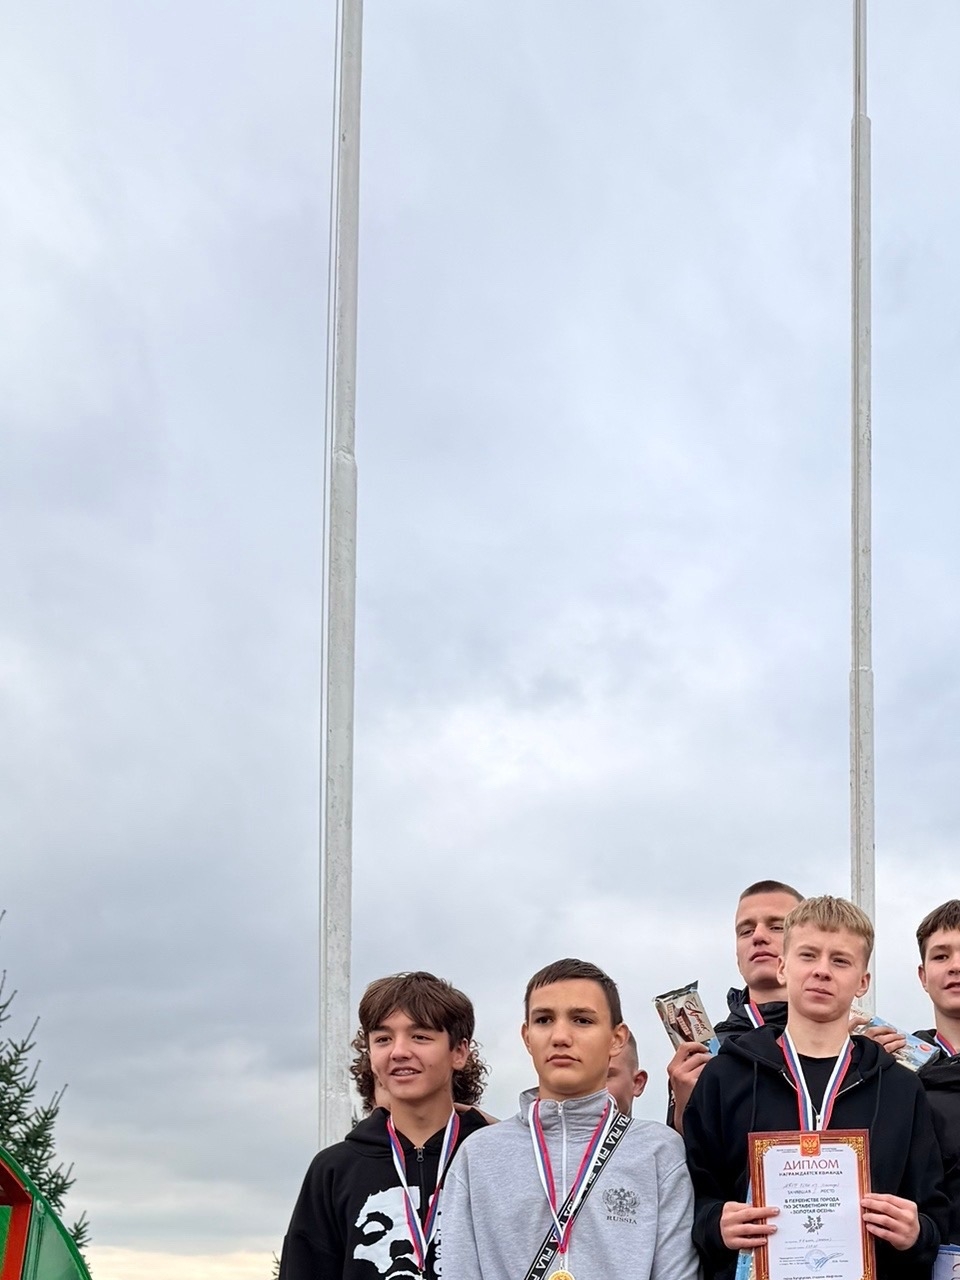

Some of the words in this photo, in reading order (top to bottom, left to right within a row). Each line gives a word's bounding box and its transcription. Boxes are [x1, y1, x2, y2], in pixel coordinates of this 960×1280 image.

[606, 1126, 623, 1145] FILA
[783, 1159, 839, 1170] ДИПЛОМ
[535, 1246, 555, 1269] FILA
